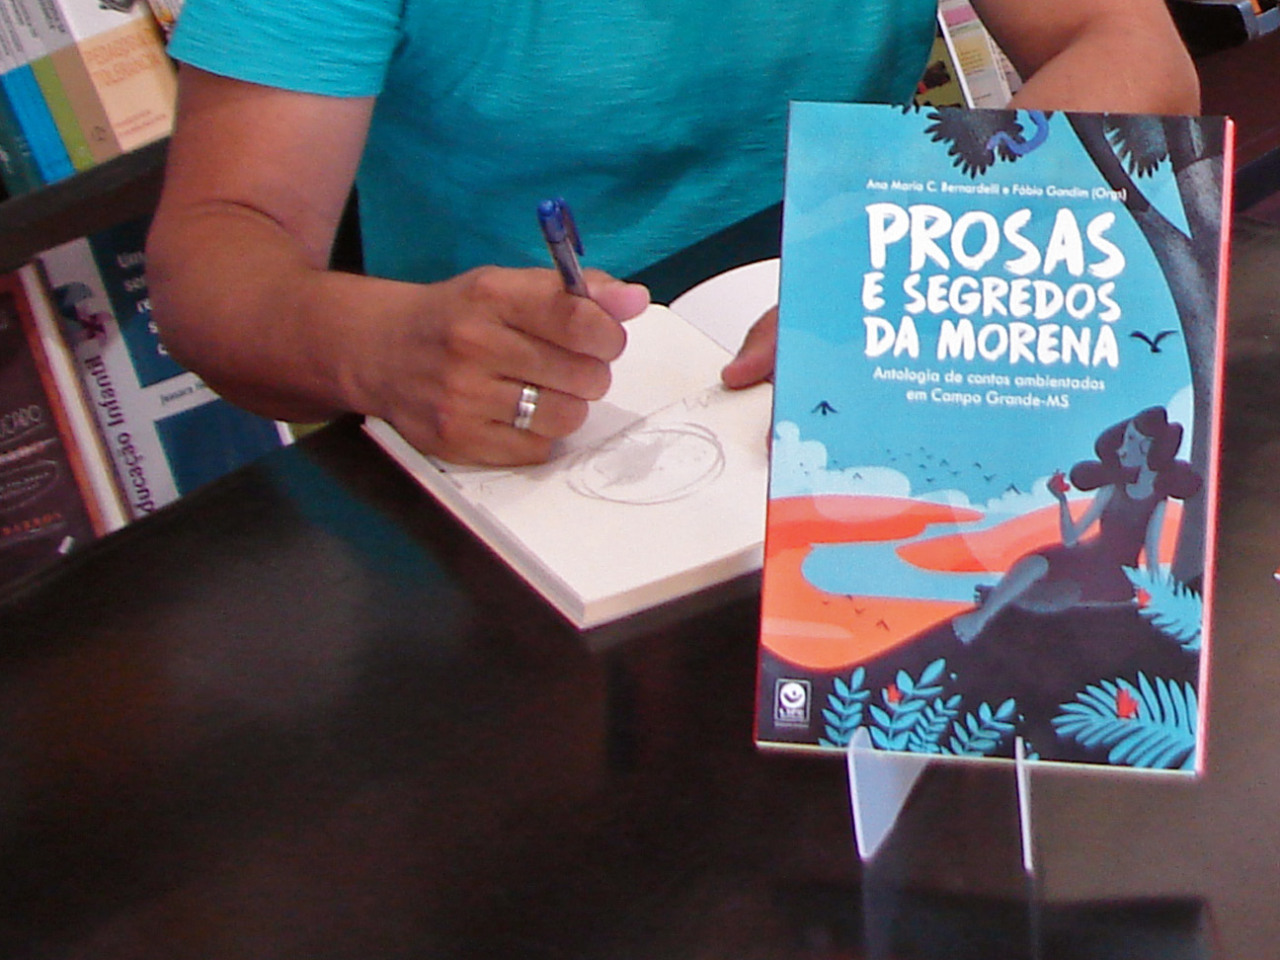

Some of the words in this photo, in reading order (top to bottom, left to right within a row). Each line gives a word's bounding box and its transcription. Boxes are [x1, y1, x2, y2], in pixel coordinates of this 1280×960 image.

[866, 178, 889, 190] Ana
[890, 180, 924, 192] Maria
[941, 181, 1000, 195] Bernardelli
[1002, 186, 1010, 195] e
[1012, 183, 1043, 197] Fábio
[865, 202, 1127, 279] PROSAS
[862, 270, 886, 311] E
[903, 273, 1122, 323] SEGREDOS
[862, 315, 920, 359] DA
[937, 318, 1120, 368] MORENA
[84, 354, 125, 428] Infantil
[873, 365, 941, 384] Antologia
[944, 368, 964, 383] de
[967, 372, 1011, 386] contos
[1014, 373, 1106, 391] ambientados
[906, 390, 928, 402] em
[931, 387, 983, 407] Campo
[986, 390, 1070, 409] Grande-MS
